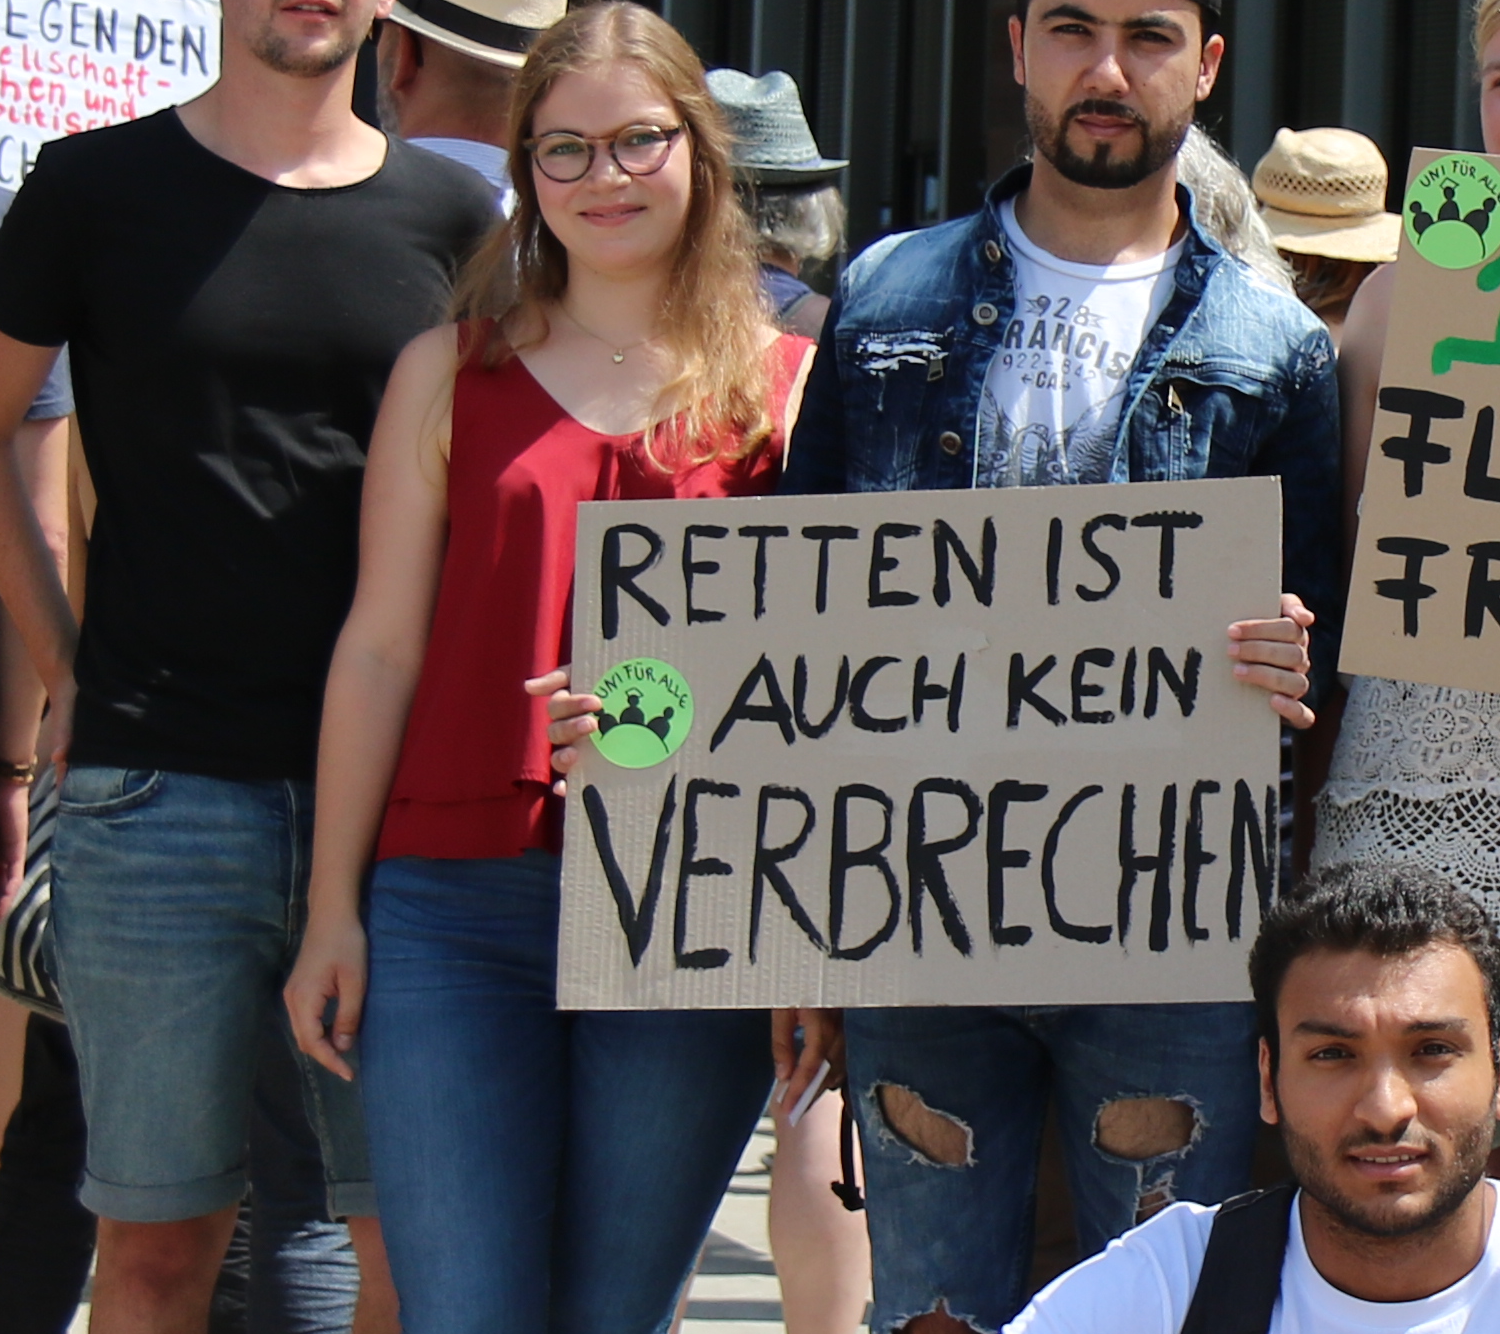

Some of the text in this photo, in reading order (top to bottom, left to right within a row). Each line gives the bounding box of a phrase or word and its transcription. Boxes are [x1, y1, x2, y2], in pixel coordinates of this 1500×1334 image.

[134, 14, 208, 76] DEN
[84, 89, 138, 121] und
[1420, 165, 1445, 187] UNI
[1451, 160, 1476, 179] FÜR
[602, 510, 1203, 639] RETTEN IST
[594, 662, 687, 708] UNI FÜR ALLE
[711, 647, 1202, 752] AUCH KEIN
[583, 773, 1276, 969] VERBRECHEN
